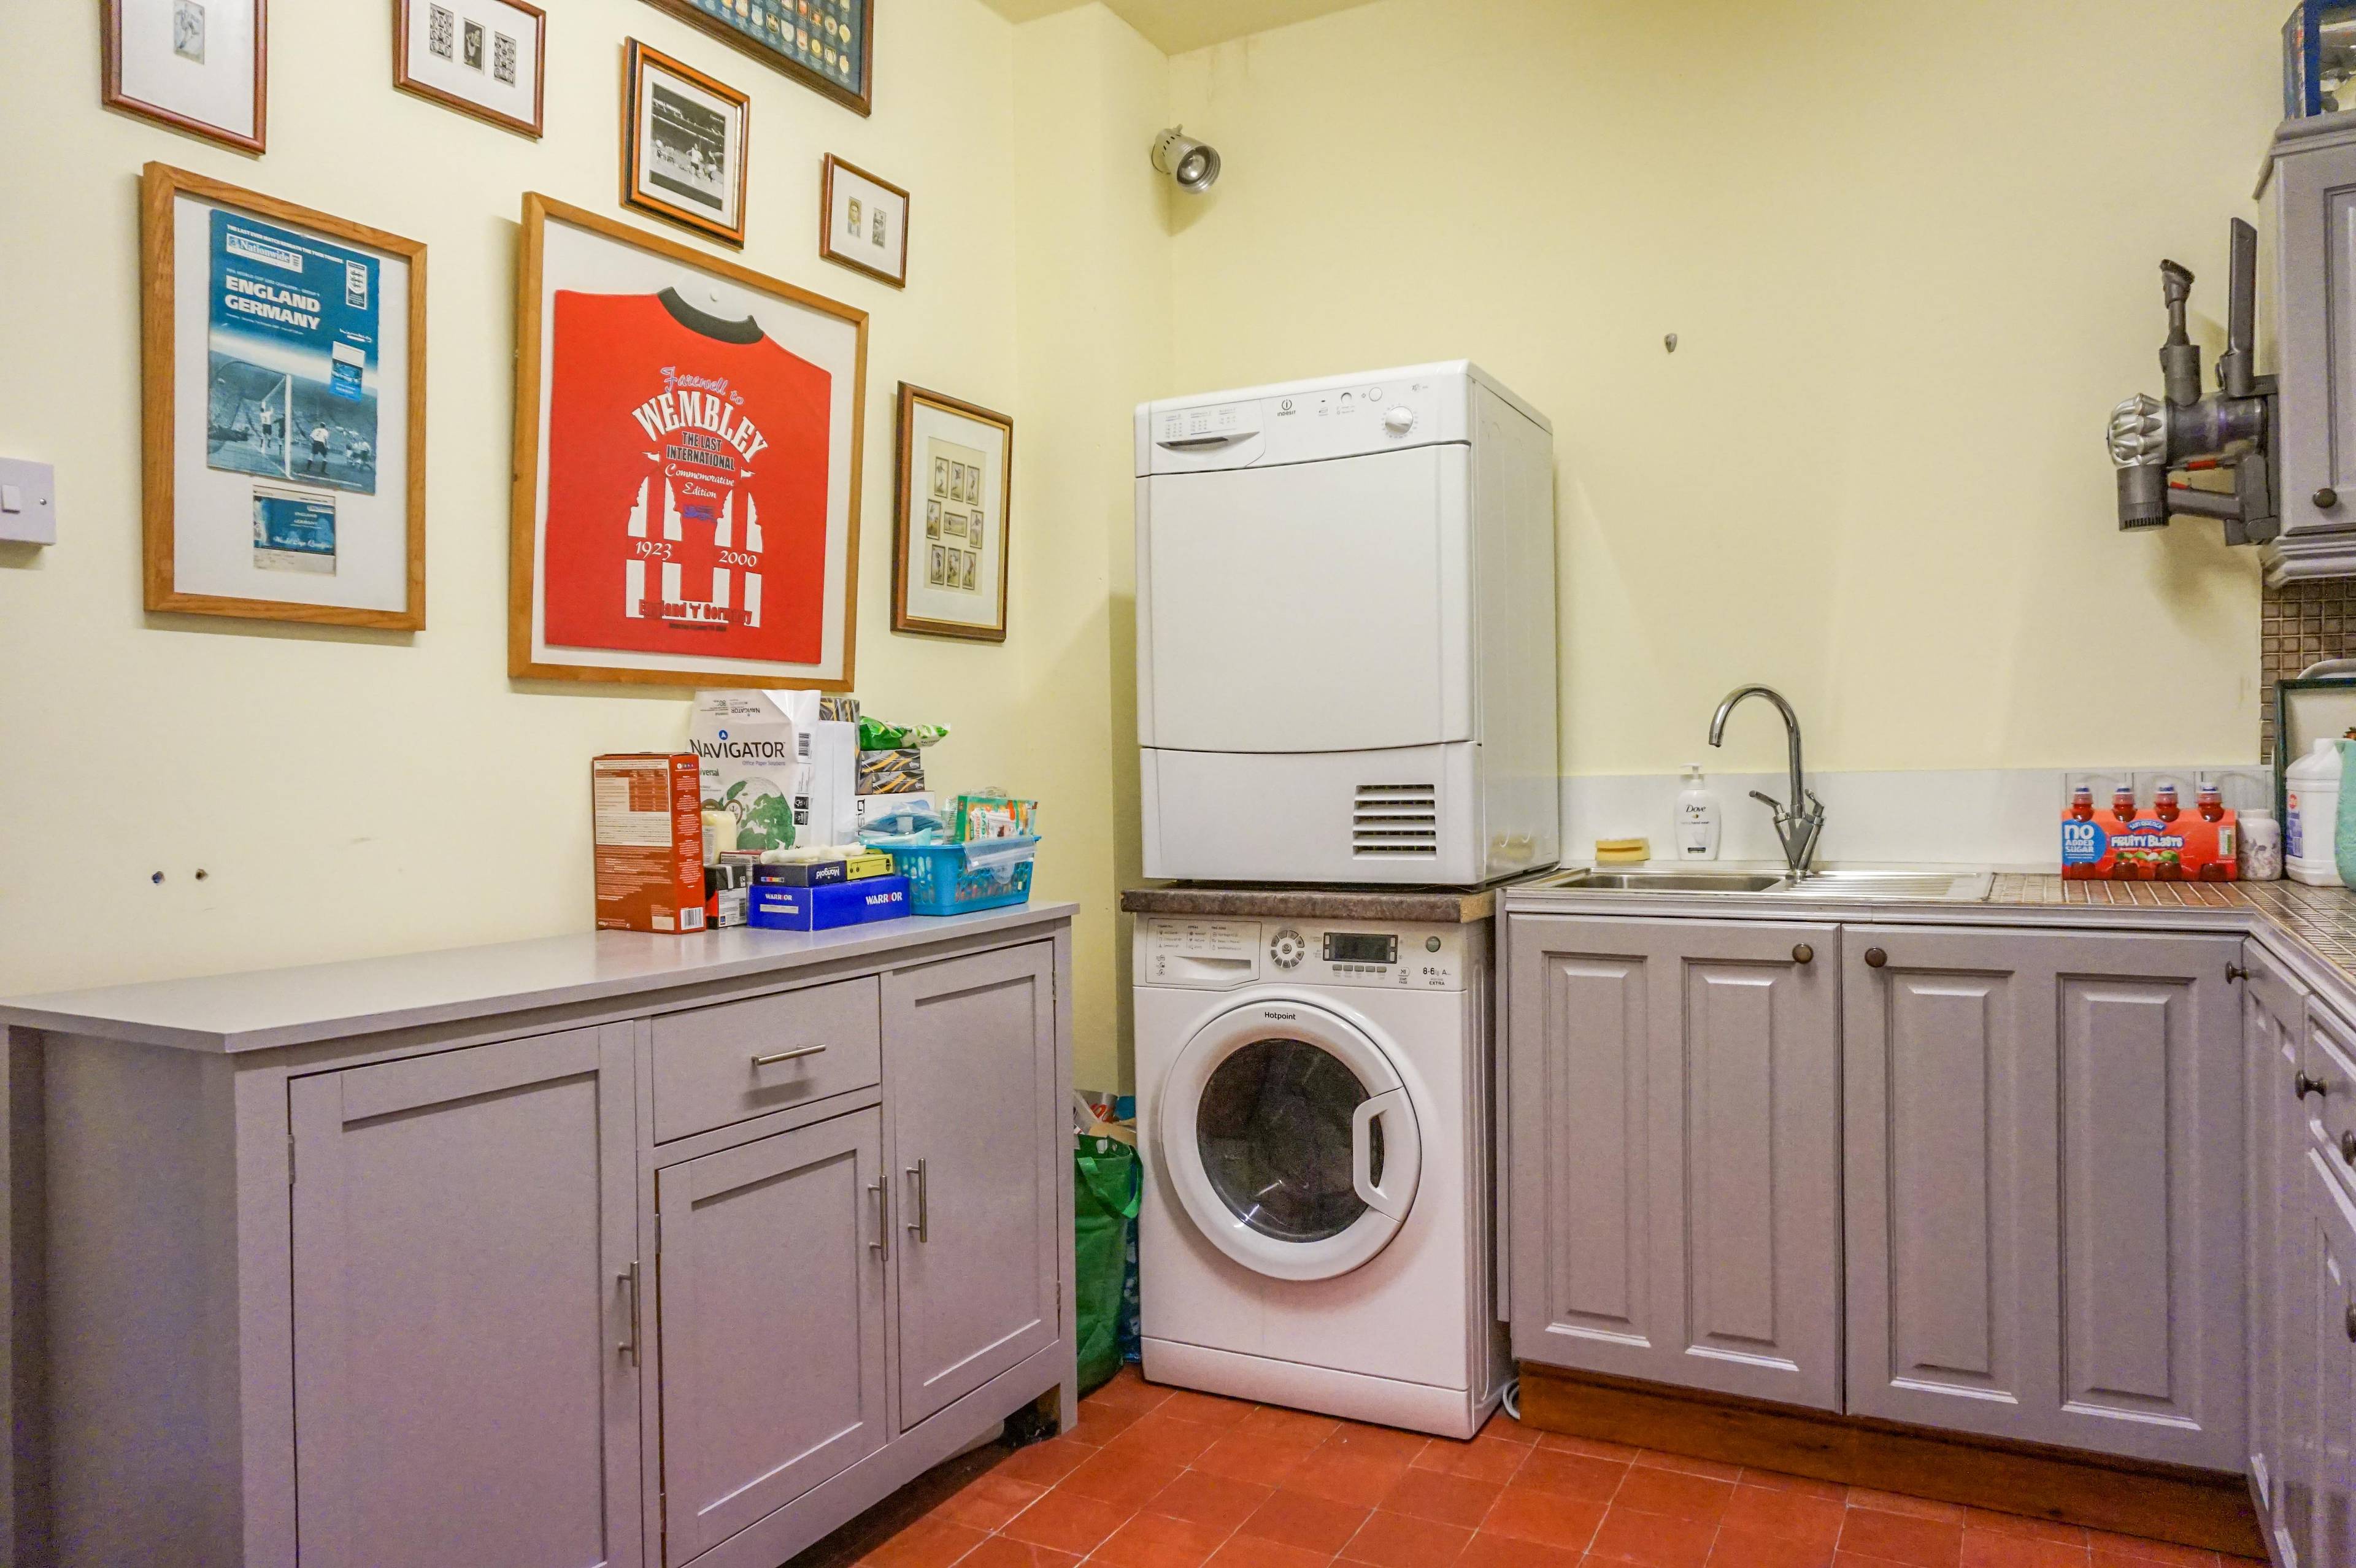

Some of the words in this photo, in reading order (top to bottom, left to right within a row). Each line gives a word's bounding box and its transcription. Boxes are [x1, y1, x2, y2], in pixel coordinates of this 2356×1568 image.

[240, 238, 290, 263] Nationwide
[226, 275, 321, 313] ENGLAND
[225, 294, 321, 330] GERMANY
[661, 366, 728, 394] Farewell
[730, 390, 744, 405] to
[632, 390, 768, 463] WEMBLEY
[682, 431, 699, 447] THE
[701, 436, 722, 452] LAST
[666, 445, 735, 471] INTERNATIONAL
[665, 464, 734, 486] Commemorative
[682, 482, 717, 499] Edition
[636, 541, 672, 560] 1923
[718, 550, 757, 567] 2000
[690, 739, 785, 758] NAVIGATOR
[2064, 824, 2095, 839] no
[815, 867, 839, 879] Marigold
[865, 891, 903, 905] WARRIOR
[1265, 1012, 1296, 1020] Hotpoint
